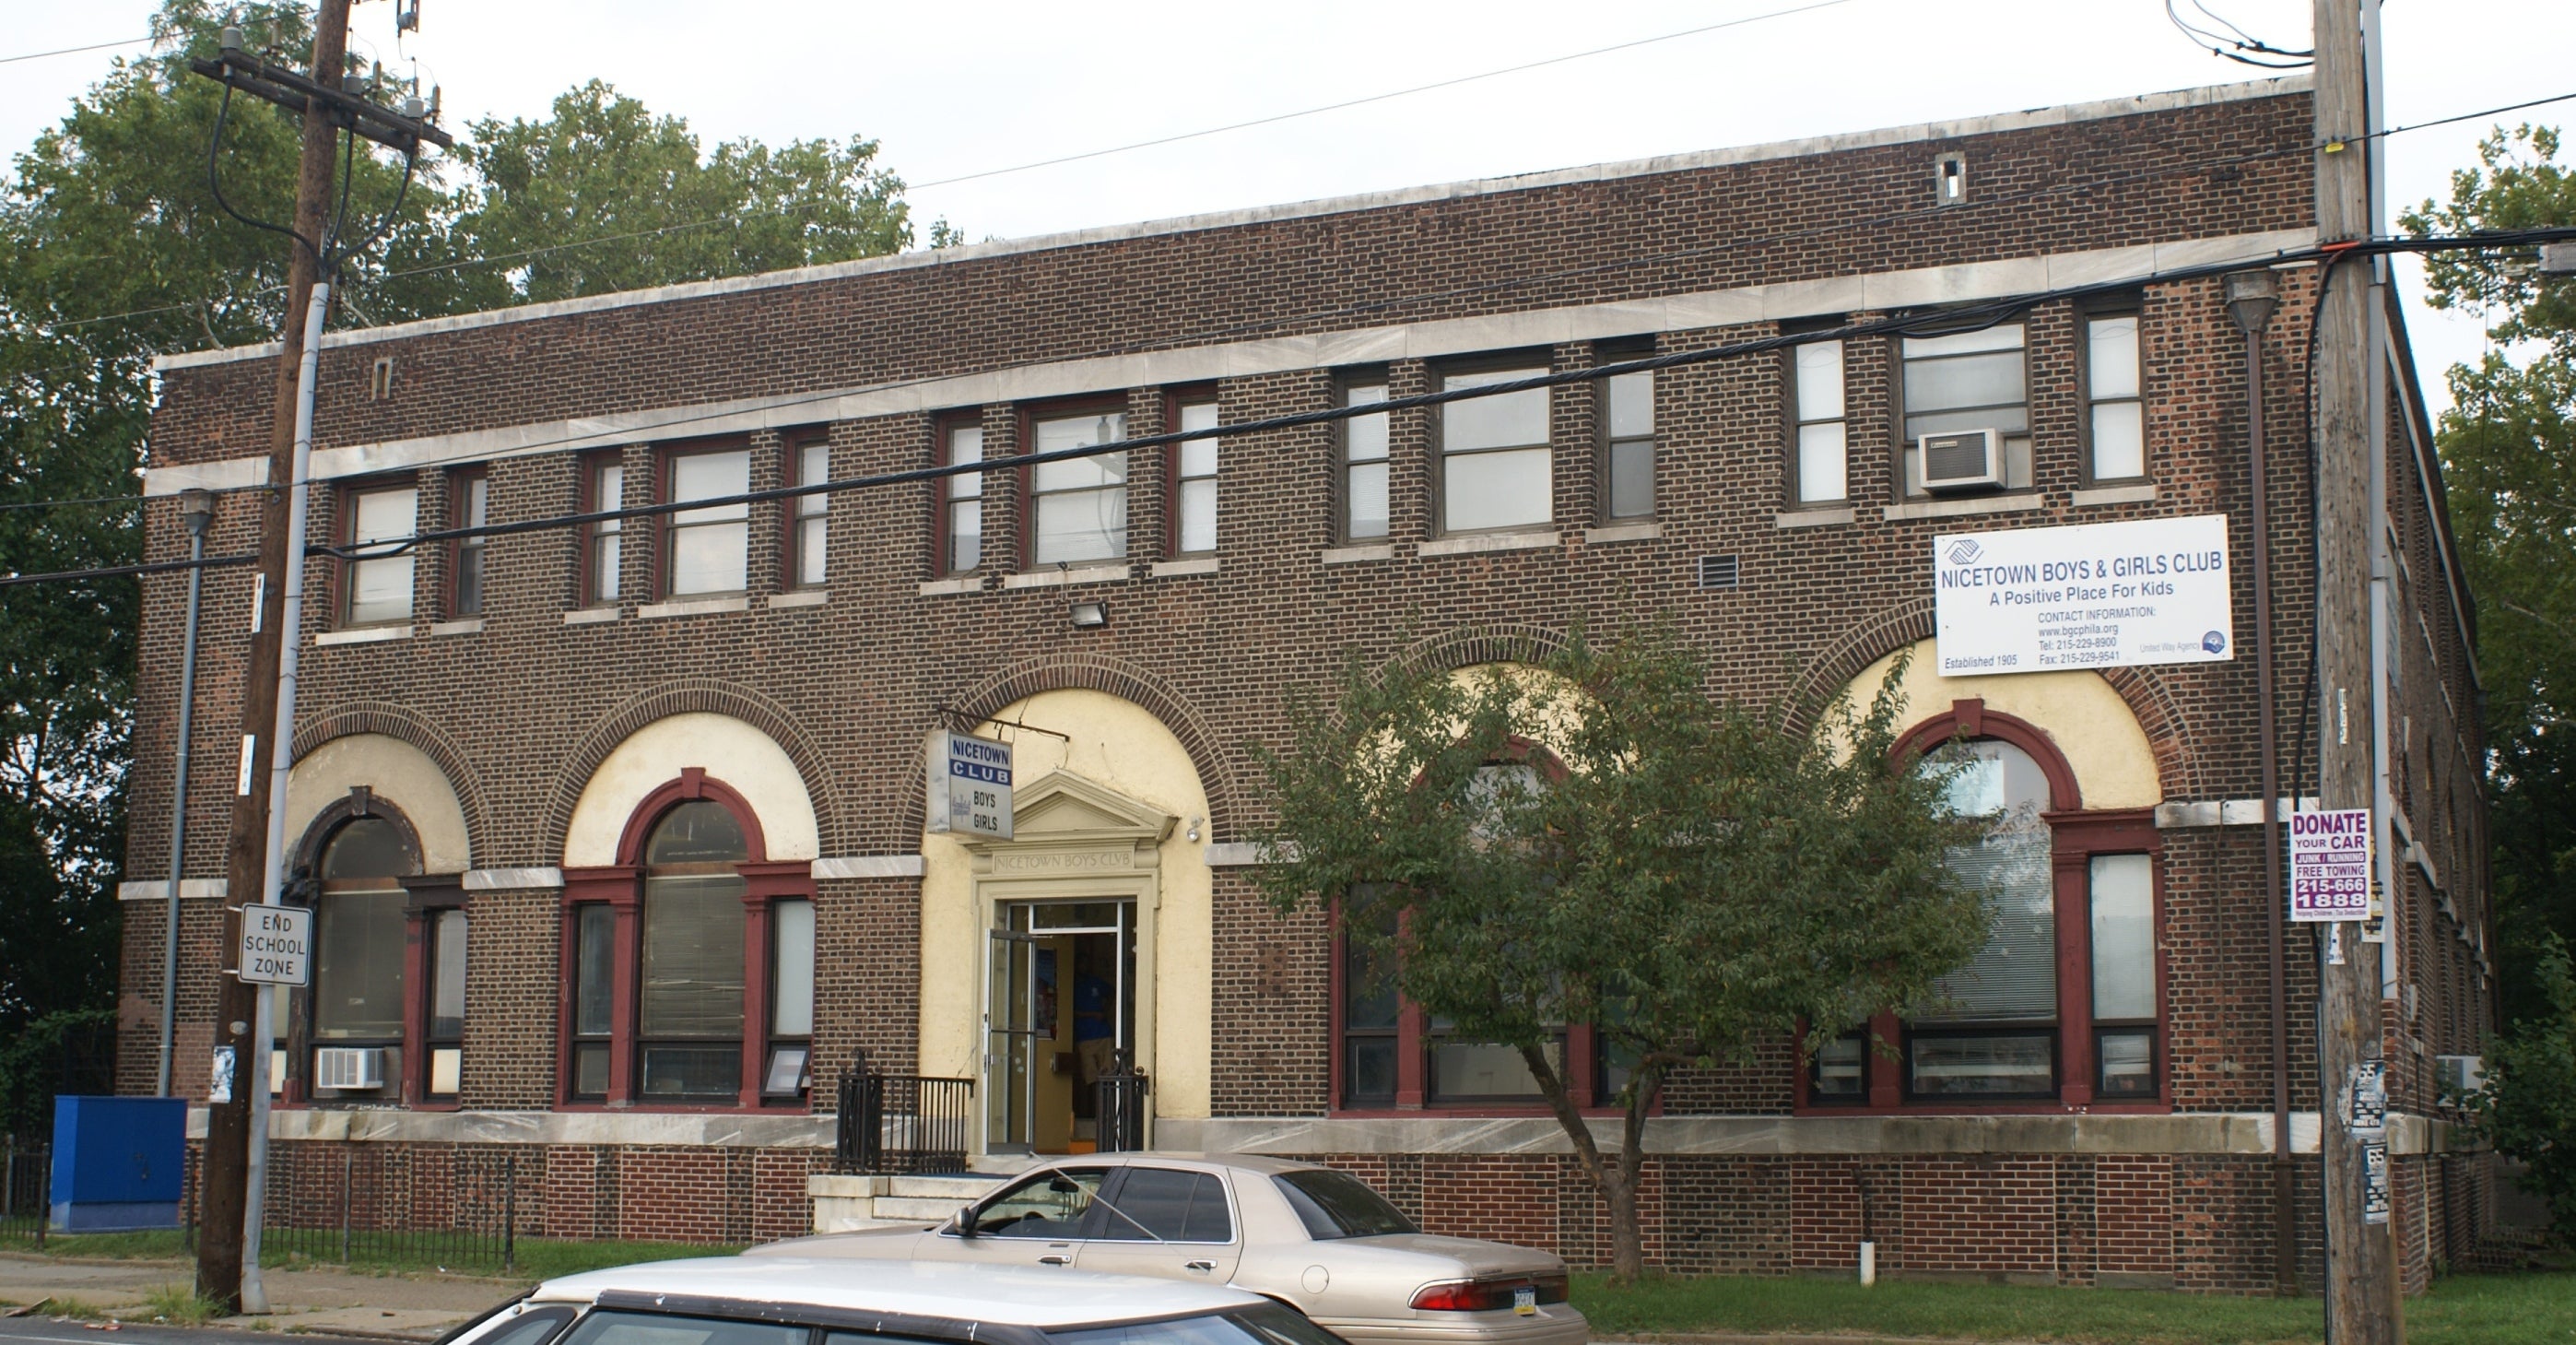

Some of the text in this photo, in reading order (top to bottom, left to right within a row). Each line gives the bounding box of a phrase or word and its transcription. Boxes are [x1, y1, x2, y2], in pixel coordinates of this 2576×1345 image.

[1941, 551, 2222, 588] NICETOWN BOYS & GIRLS CLUB
[1990, 581, 2174, 606] A Positive Place For Kids
[2038, 607, 2156, 623] CONTACT INFORMATION:
[2039, 623, 2119, 638] www.bgcphila.org
[2039, 637, 2116, 651] Tel: 215-229-8900
[1945, 655, 2017, 669] Established 1905
[2040, 651, 2120, 665] Fax: 215-229-9541
[953, 739, 1008, 765] NICETOWN
[953, 761, 1008, 784] CLUB
[973, 791, 995, 808] BOYS
[973, 813, 997, 832] GIRLS
[2293, 812, 2366, 835] DONATE
[2295, 835, 2365, 850] YOUR CAR
[997, 855, 1060, 870] NICETOWN
[1065, 854, 1097, 867] BOYS
[2297, 855, 2321, 864] JUNK
[2327, 852, 2364, 863] RUNNING
[2297, 865, 2365, 877] FREE TOWING
[2298, 879, 2364, 892] 215-666
[2297, 894, 2366, 908] 1888
[262, 915, 292, 932] END
[245, 936, 305, 955] SCHOOL
[254, 958, 294, 975] ZONE
[2367, 1148, 2384, 1164] 65
